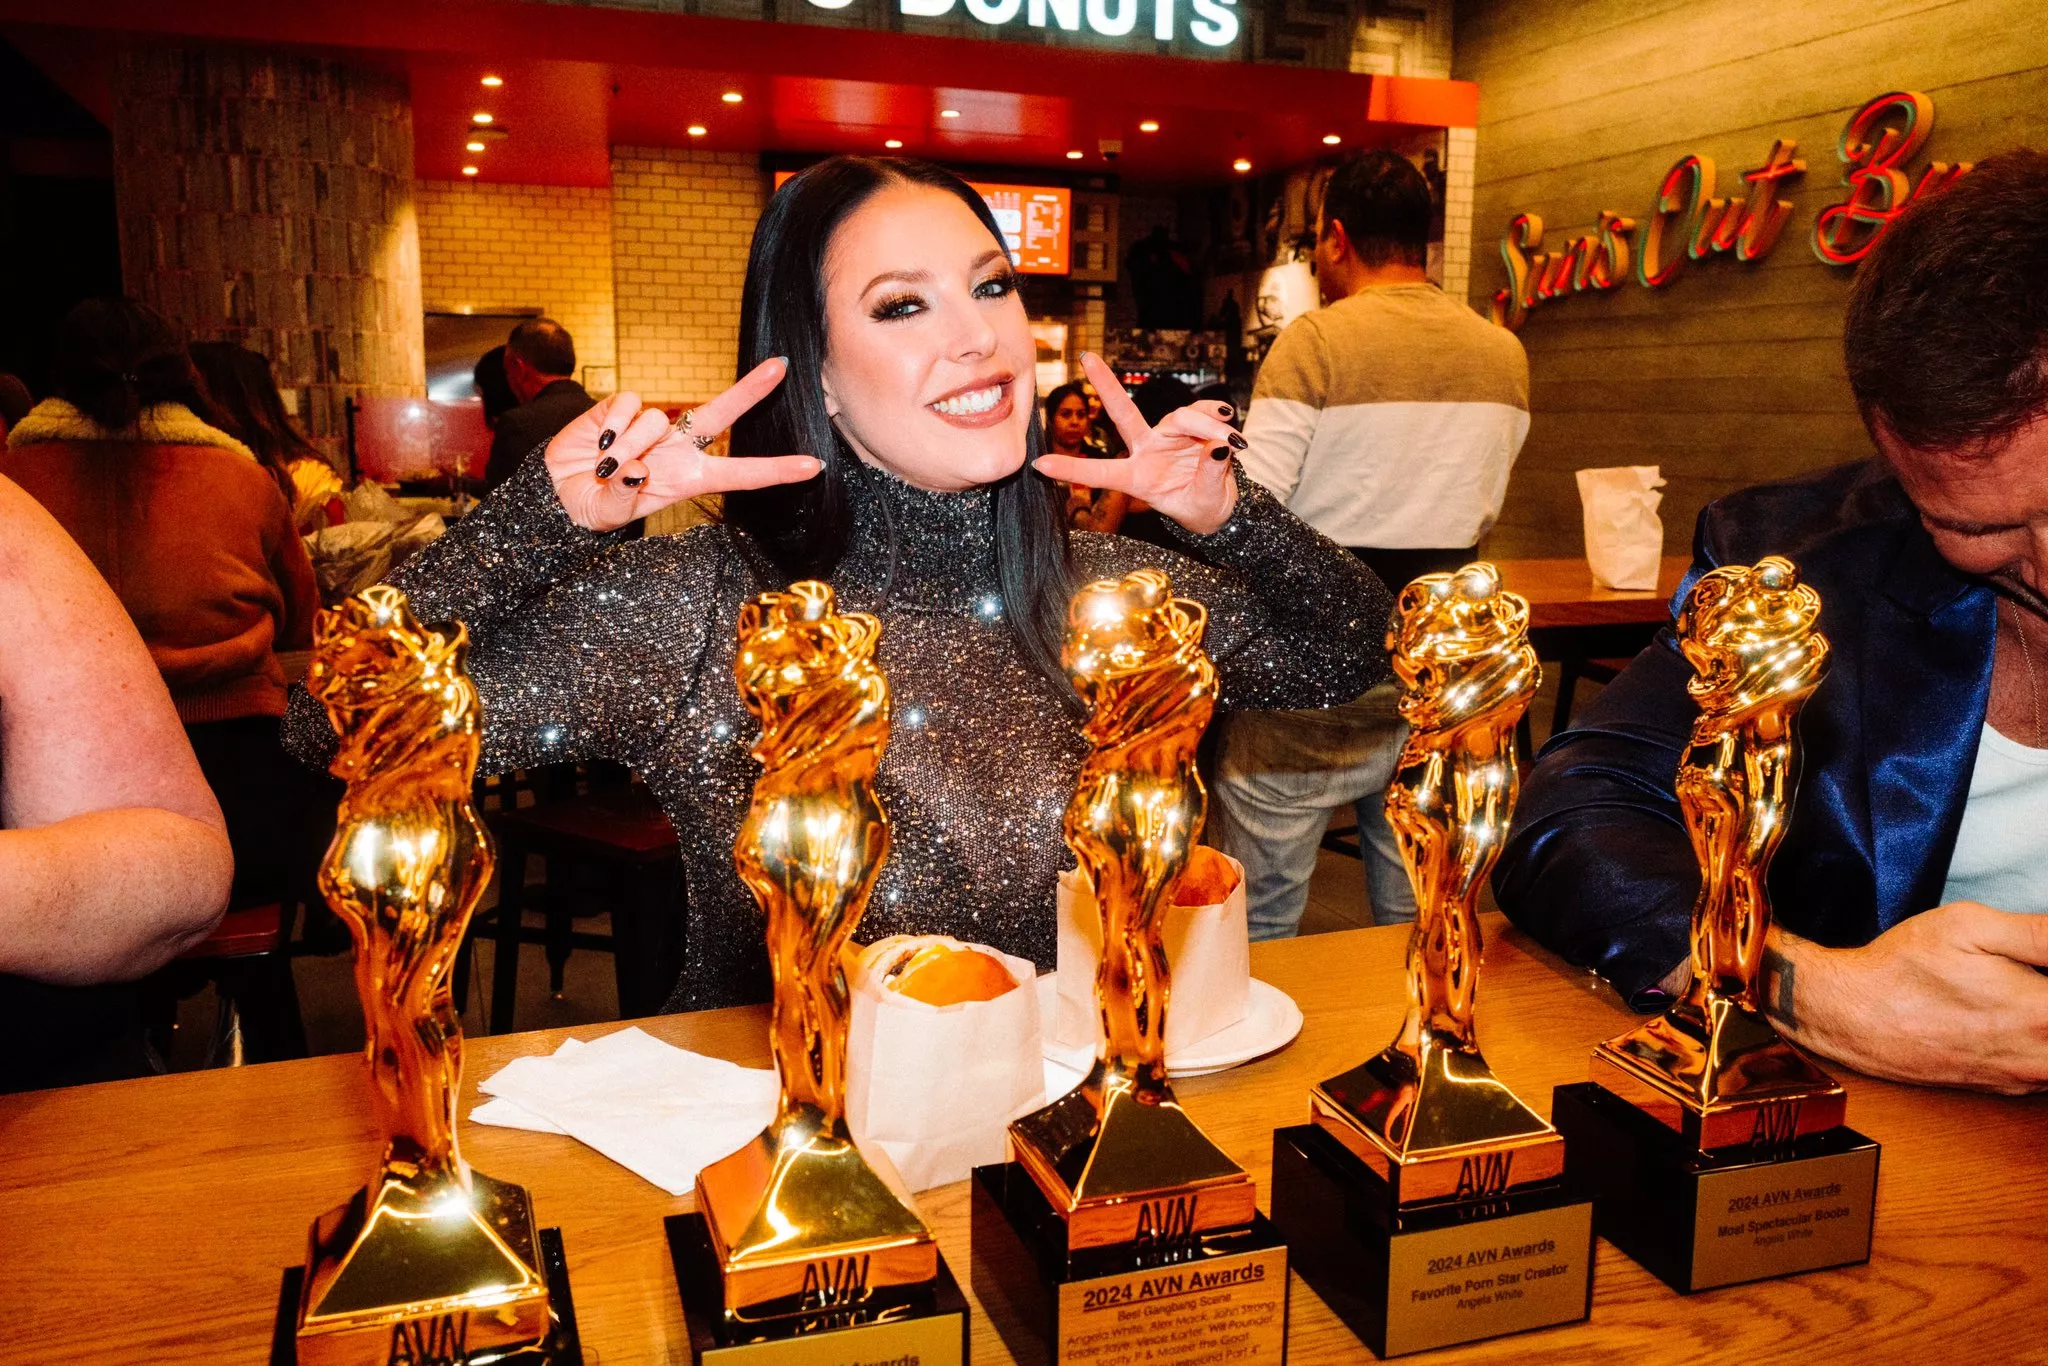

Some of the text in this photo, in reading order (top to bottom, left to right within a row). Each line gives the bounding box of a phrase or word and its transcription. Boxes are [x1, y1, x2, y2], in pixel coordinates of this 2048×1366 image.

[1636, 140, 1806, 288] Out
[1751, 1101, 1800, 1147] AVN
[1455, 1150, 1513, 1199] AVN
[1728, 1182, 1842, 1213] 2024 AVN Awards
[1134, 1195, 1197, 1246] AVN
[1718, 1207, 1850, 1237] Most Spectacular Boobs
[1428, 1239, 1556, 1273] 2024 AVN Awards
[801, 1254, 870, 1309] AVN
[1083, 1262, 1265, 1308] 2024 AVN Awards
[1411, 1263, 1569, 1302] Favorite Porn Star Creator
[1495, 1289, 1524, 1302] White
[1144, 1300, 1197, 1317] Gangbang
[1200, 1293, 1232, 1308] Scene
[387, 1310, 469, 1366] AVN
